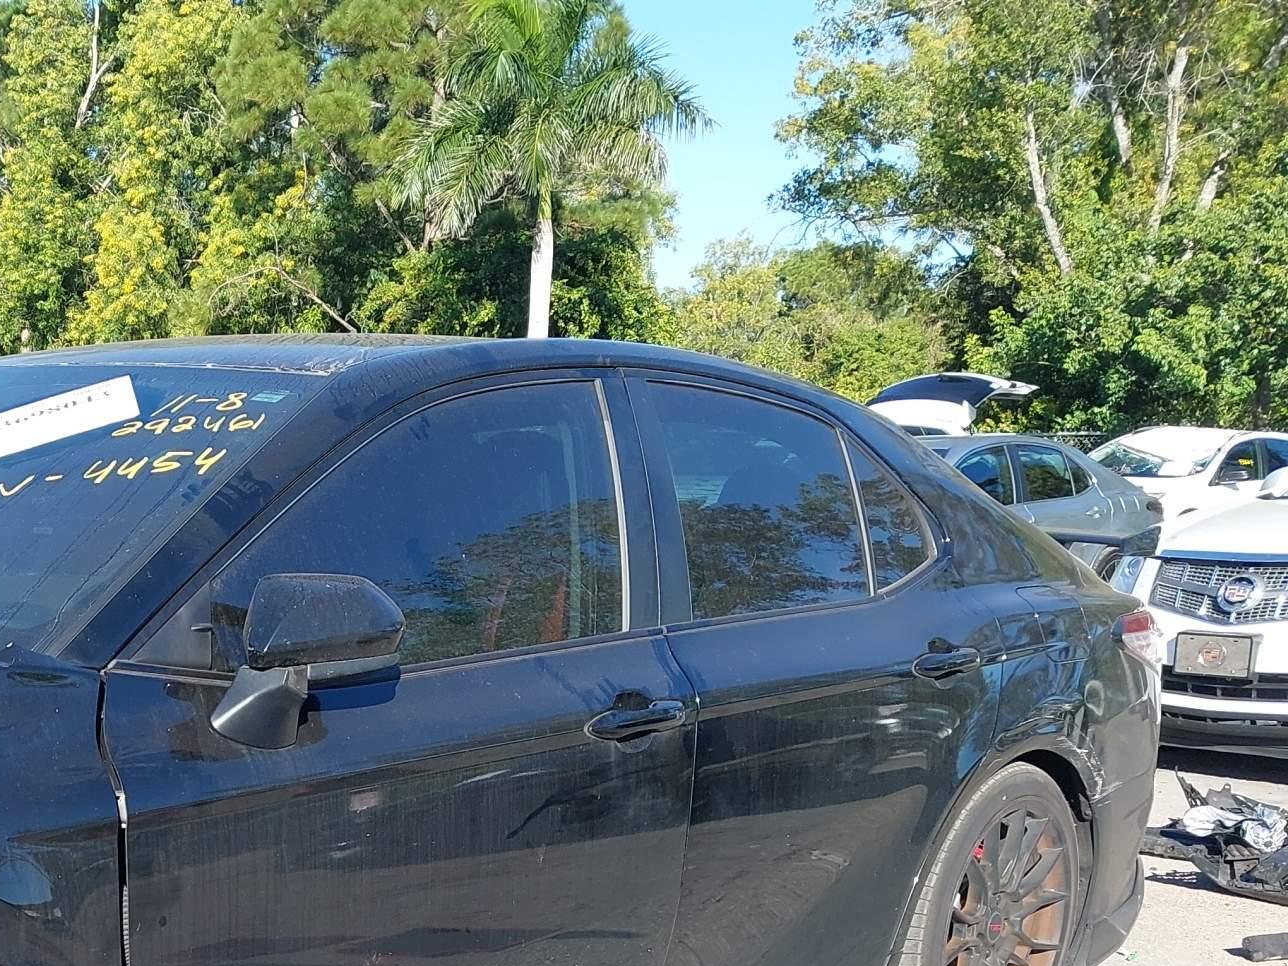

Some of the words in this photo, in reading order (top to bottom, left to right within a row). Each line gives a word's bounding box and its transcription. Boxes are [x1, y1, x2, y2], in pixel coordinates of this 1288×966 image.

[150, 391, 248, 418] 11-8
[111, 412, 266, 438] 292461
[82, 446, 228, 484] 4454
